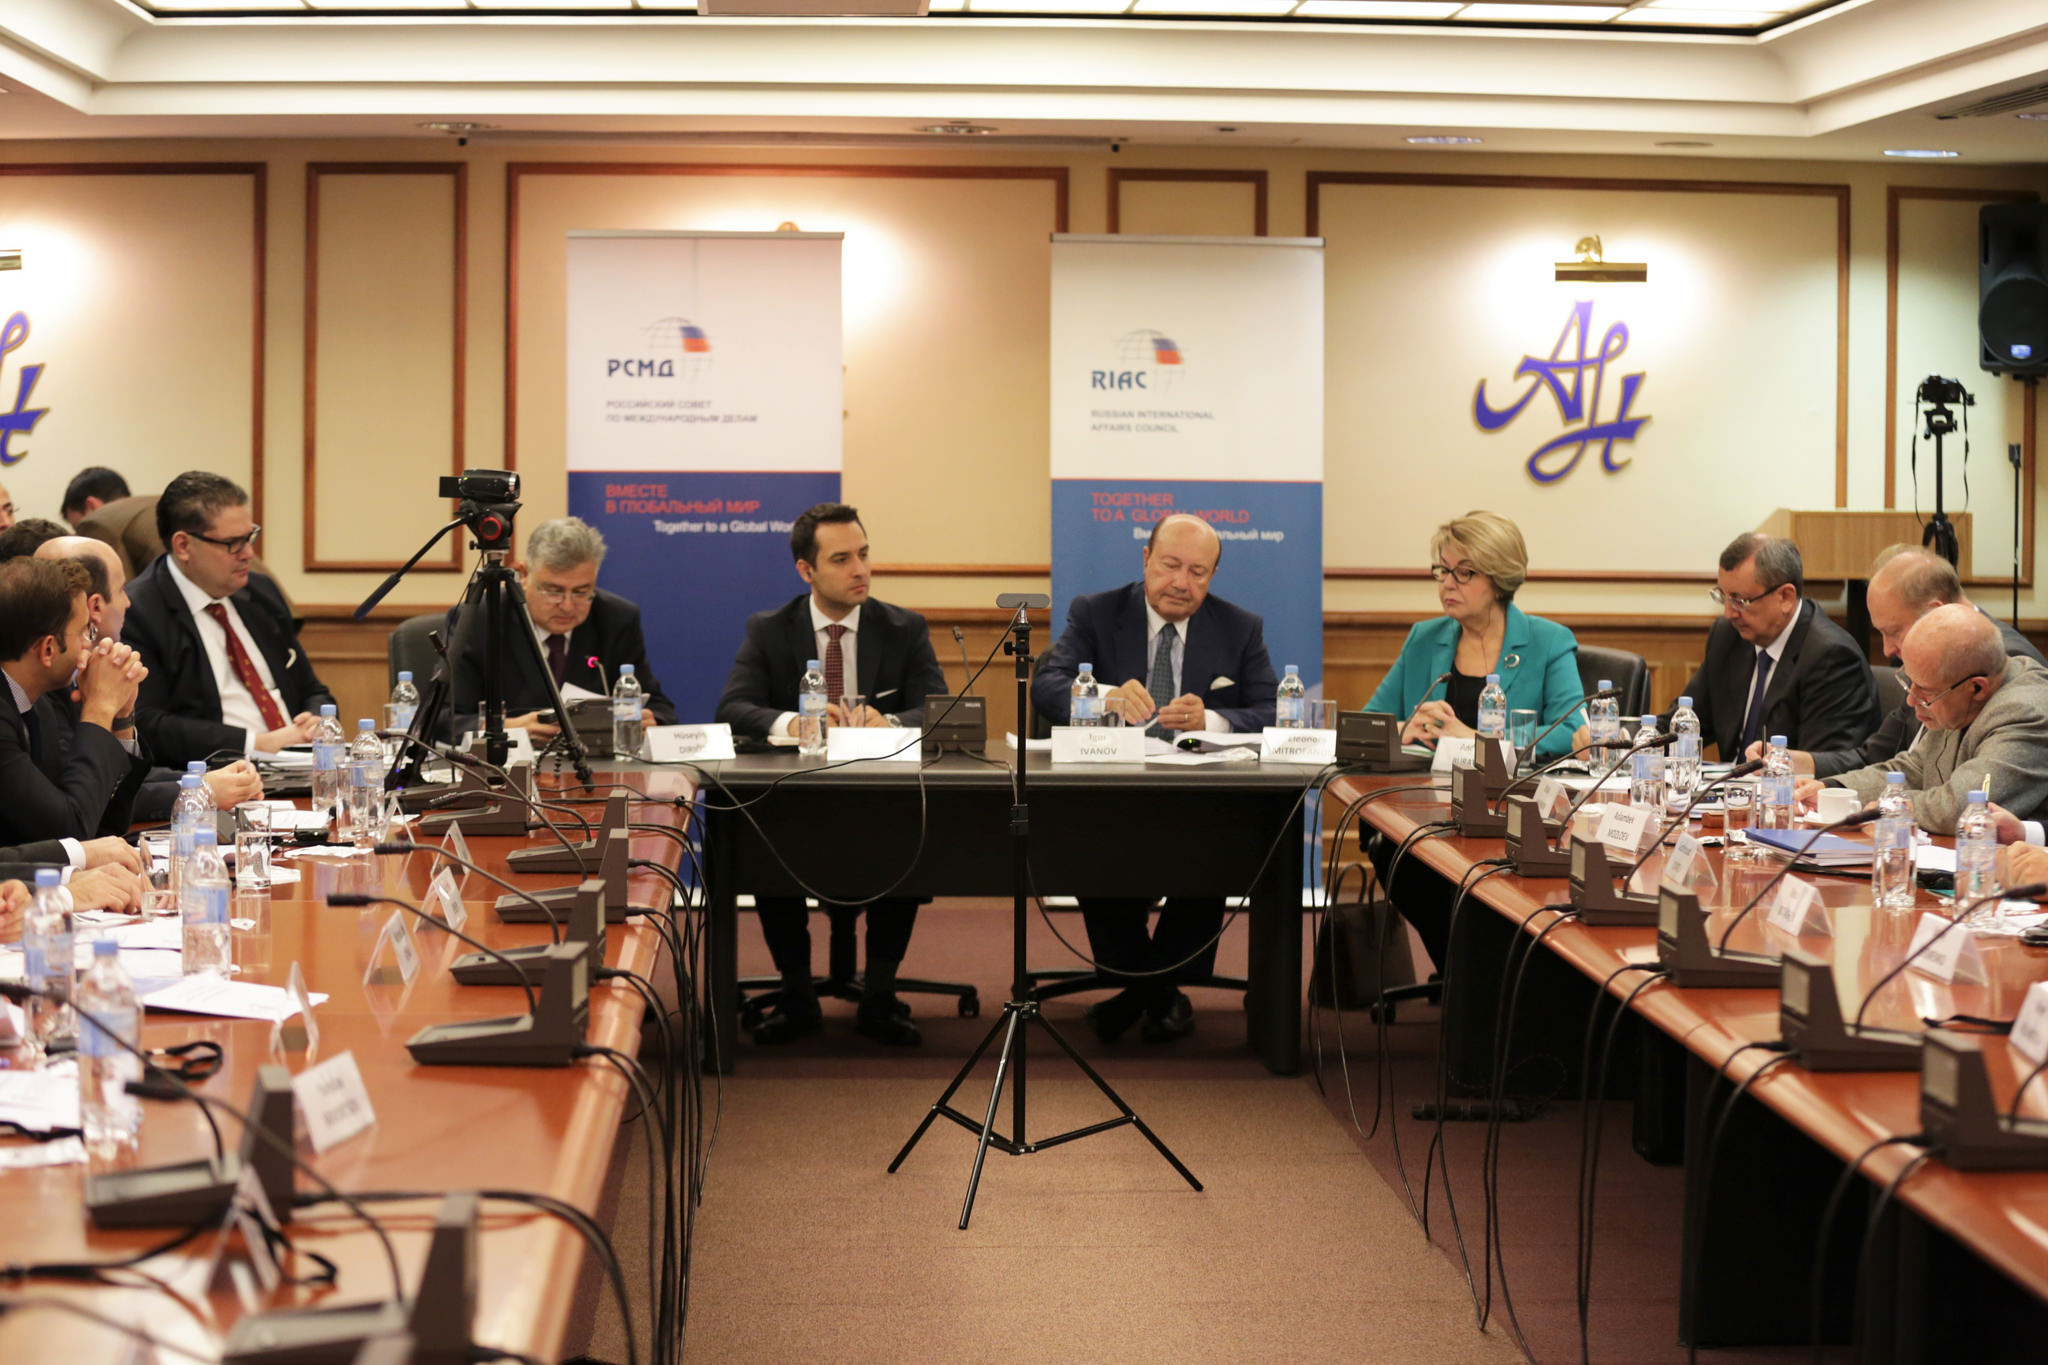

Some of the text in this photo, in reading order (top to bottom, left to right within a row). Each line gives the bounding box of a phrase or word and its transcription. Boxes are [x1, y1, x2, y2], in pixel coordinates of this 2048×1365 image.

[607, 359, 675, 378] РСМД
[1091, 370, 1147, 390] RIAC
[1091, 409, 1214, 421] RUSSIAN INTERNATIONAL
[1091, 423, 1178, 433] AFFAIRS COUNCIL
[605, 484, 668, 498] ВМЕСТЕ
[605, 498, 760, 513] В ГЛОБАЛЬНЫЙ МИР
[1090, 492, 1174, 507] TOGETHER
[1091, 508, 1112, 522] TO
[1113, 508, 1126, 522] A
[653, 519, 796, 535] Together to a Global Wor
[1080, 747, 1117, 756] IVANOV
